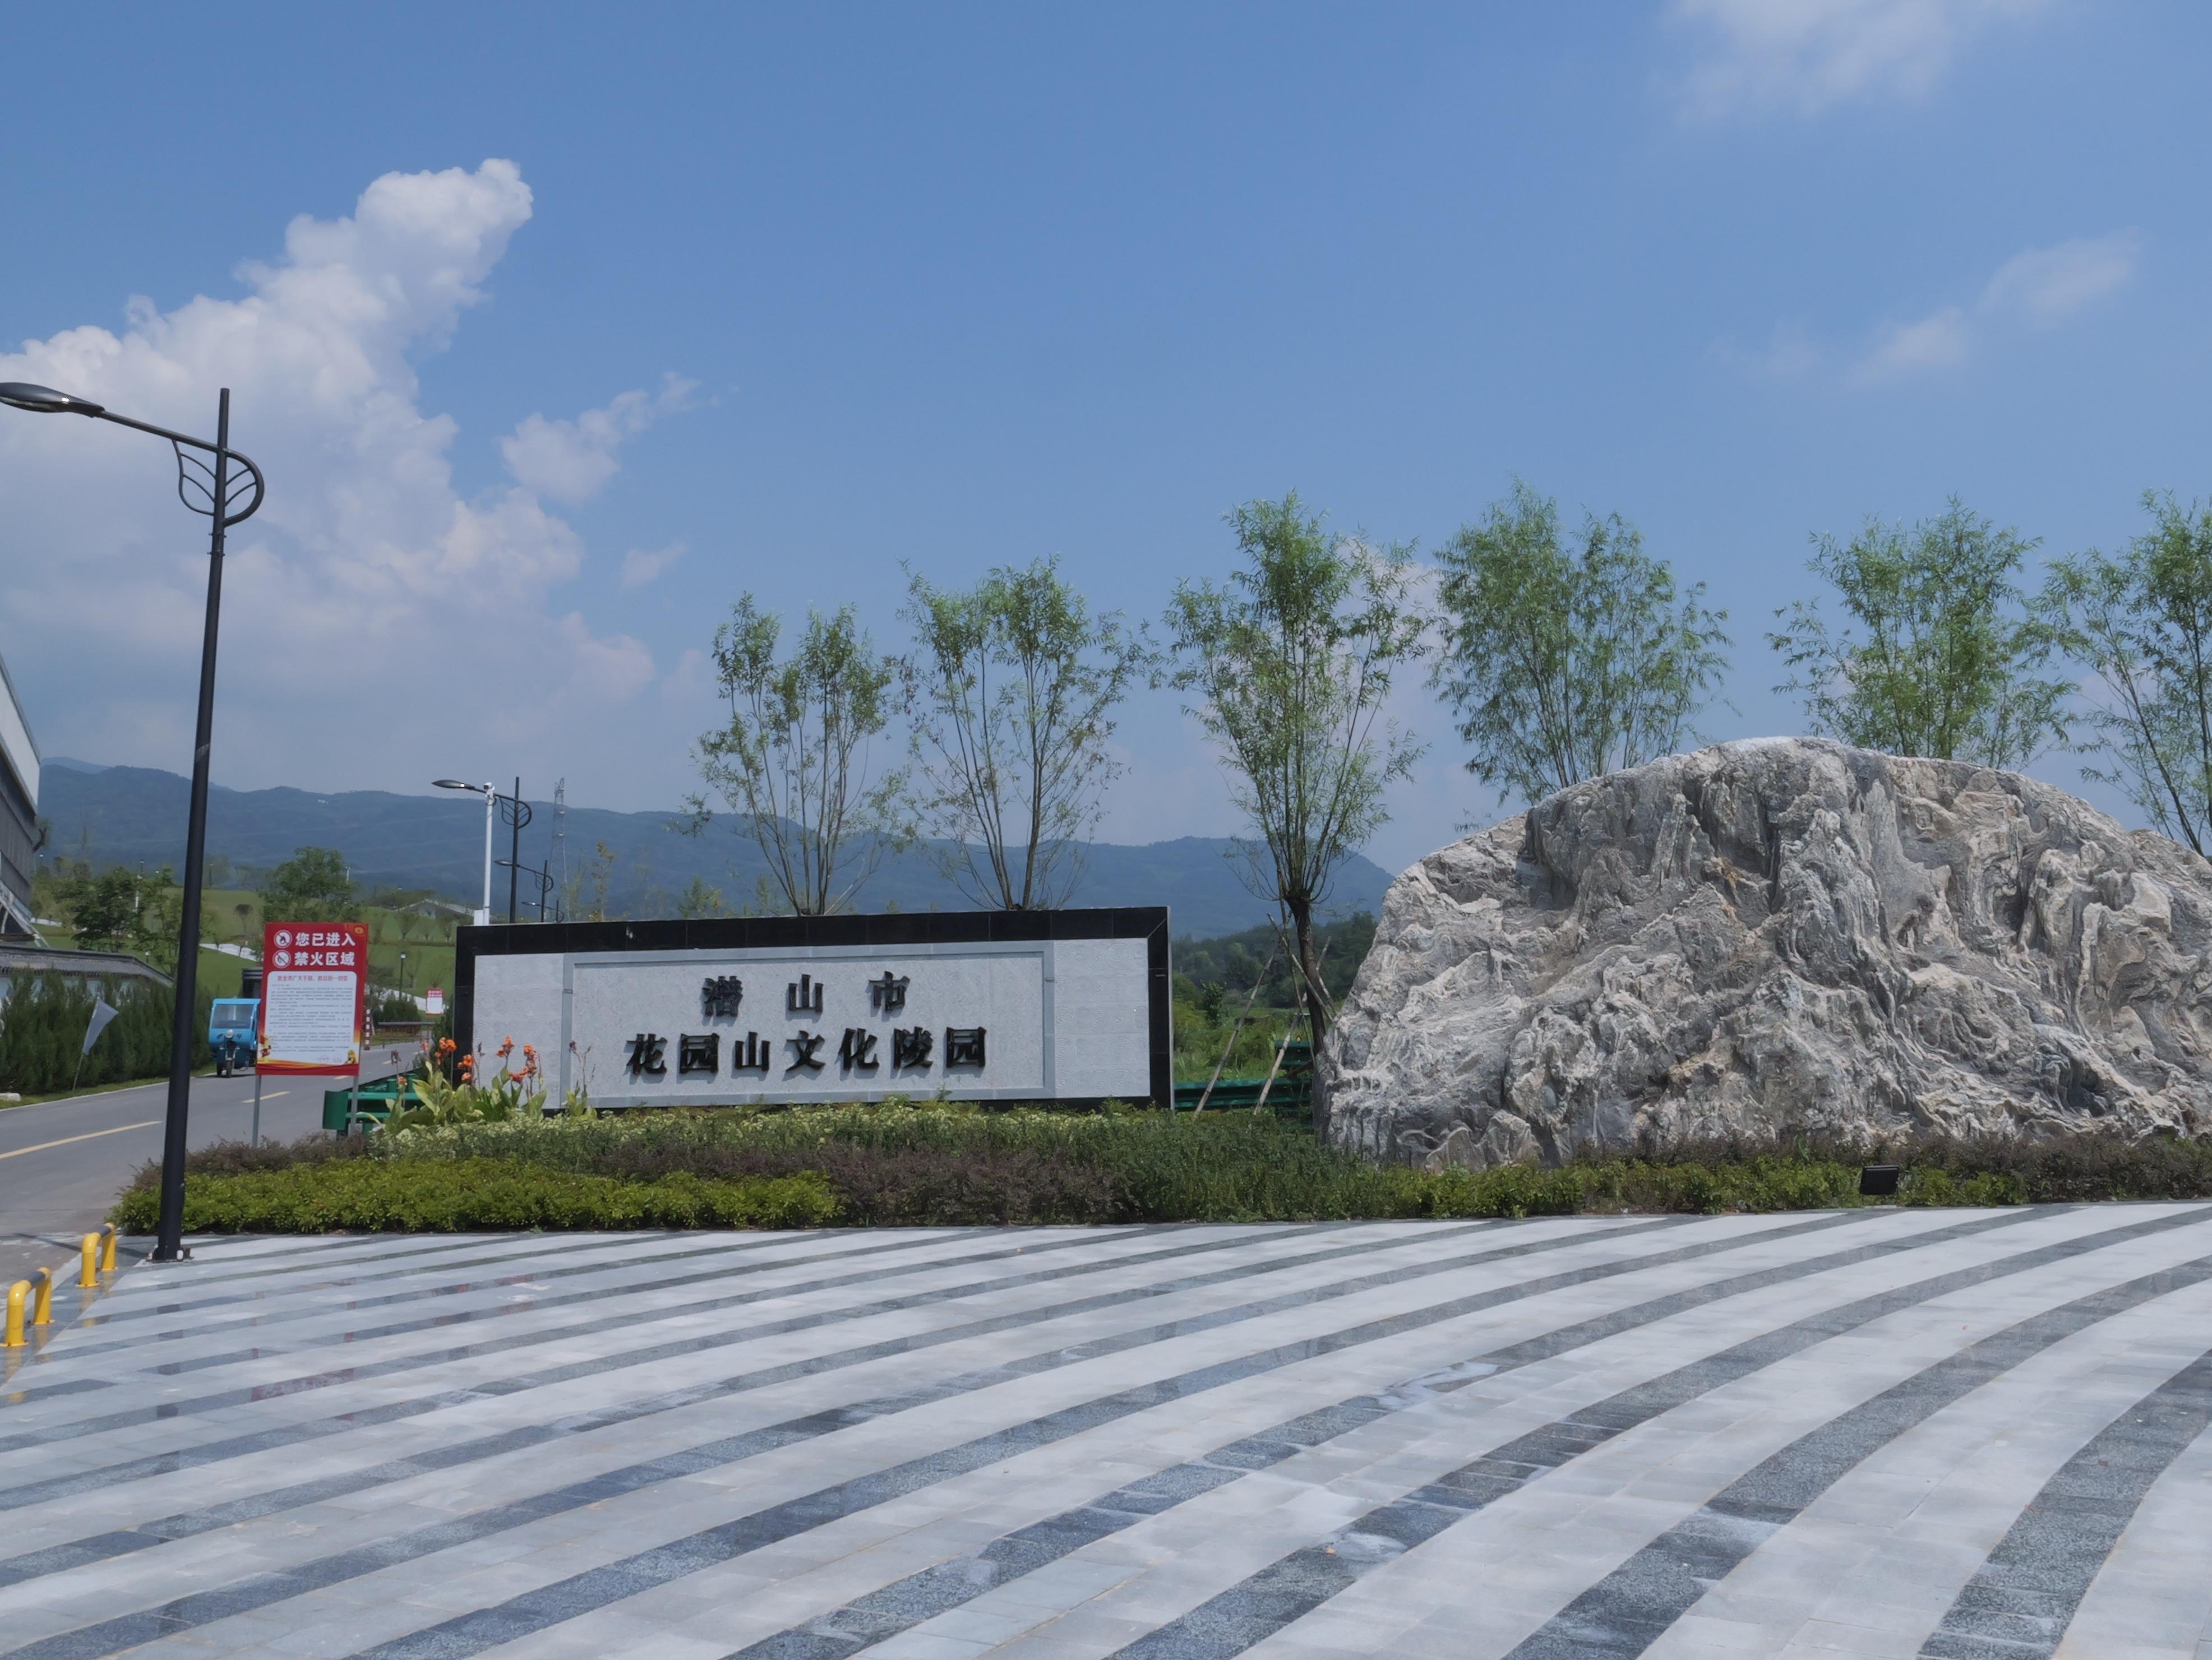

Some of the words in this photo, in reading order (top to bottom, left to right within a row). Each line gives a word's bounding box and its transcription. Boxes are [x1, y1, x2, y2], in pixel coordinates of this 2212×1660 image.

[295, 932, 355, 946] 您已进入
[294, 951, 355, 966] 禁火区域
[701, 970, 911, 1017] 潜山市
[627, 1026, 986, 1075] 花园山文化陵园
